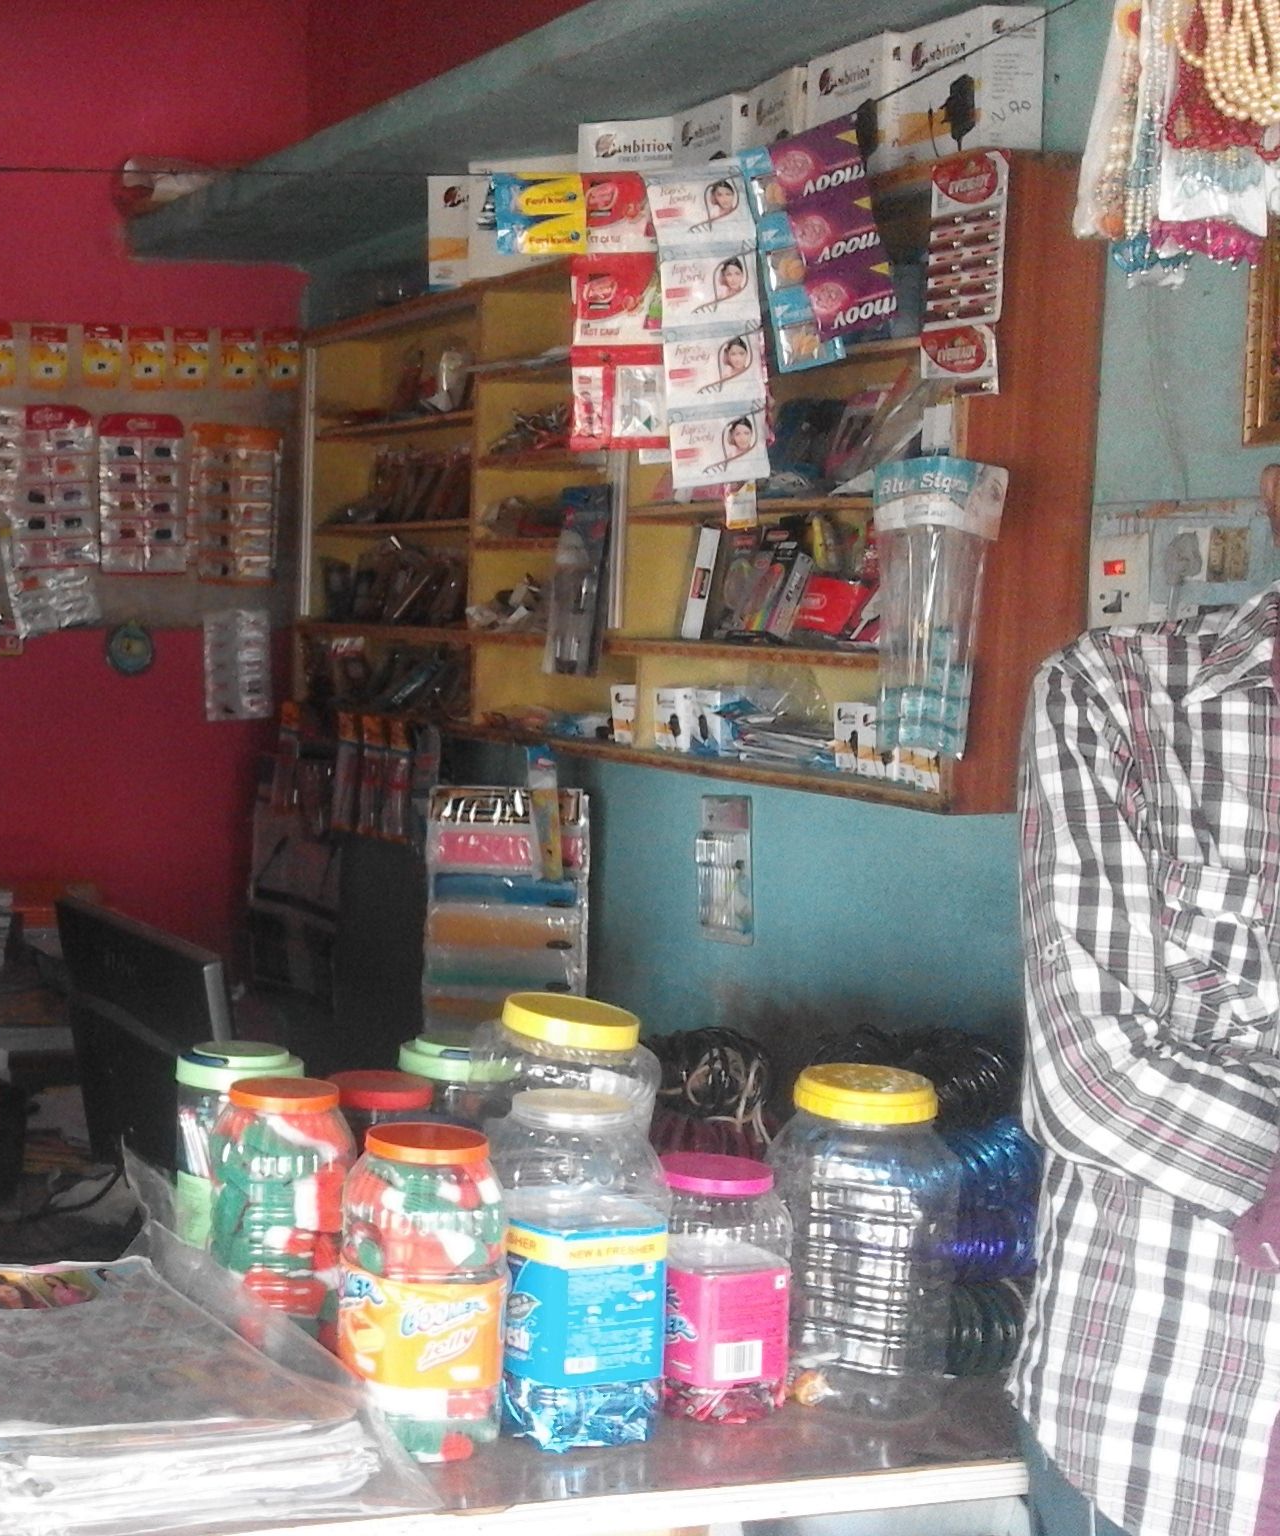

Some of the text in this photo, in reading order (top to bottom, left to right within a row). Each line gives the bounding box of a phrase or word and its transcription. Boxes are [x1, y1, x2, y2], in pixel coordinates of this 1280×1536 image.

[505, 1230, 537, 1250] SHER
[569, 1248, 593, 1258] NEW
[606, 1243, 656, 1256] FRESHER
